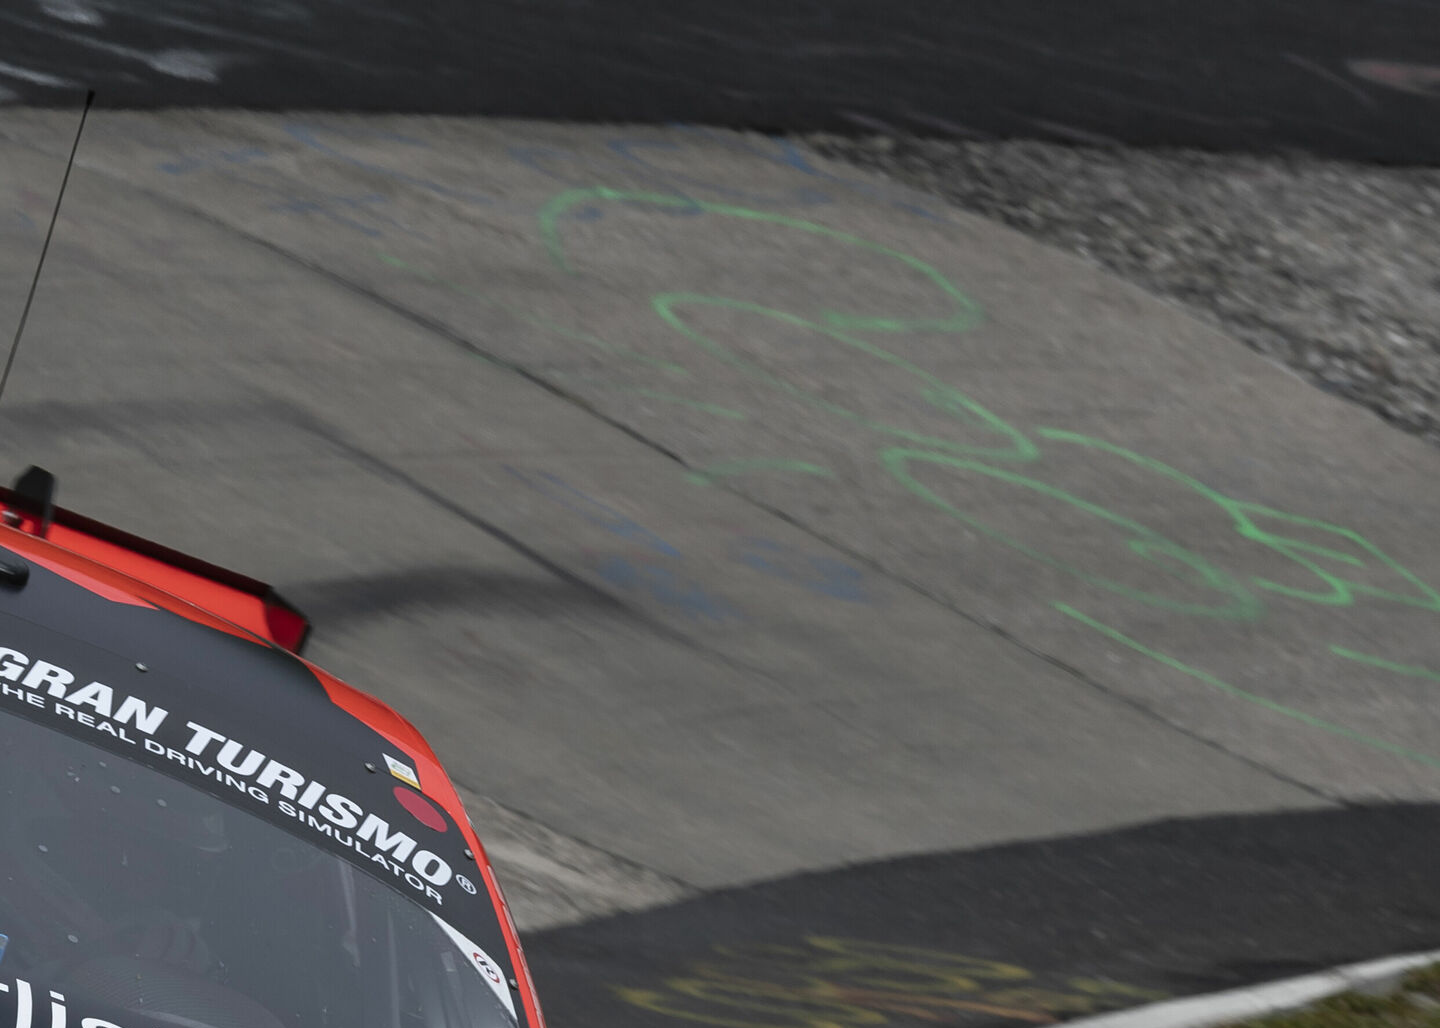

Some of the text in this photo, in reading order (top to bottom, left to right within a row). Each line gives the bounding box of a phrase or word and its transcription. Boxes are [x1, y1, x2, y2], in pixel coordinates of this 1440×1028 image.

[55, 702, 136, 745] REAL
[144, 738, 269, 805] DRIVING
[278, 800, 443, 905] SIMULATOR
